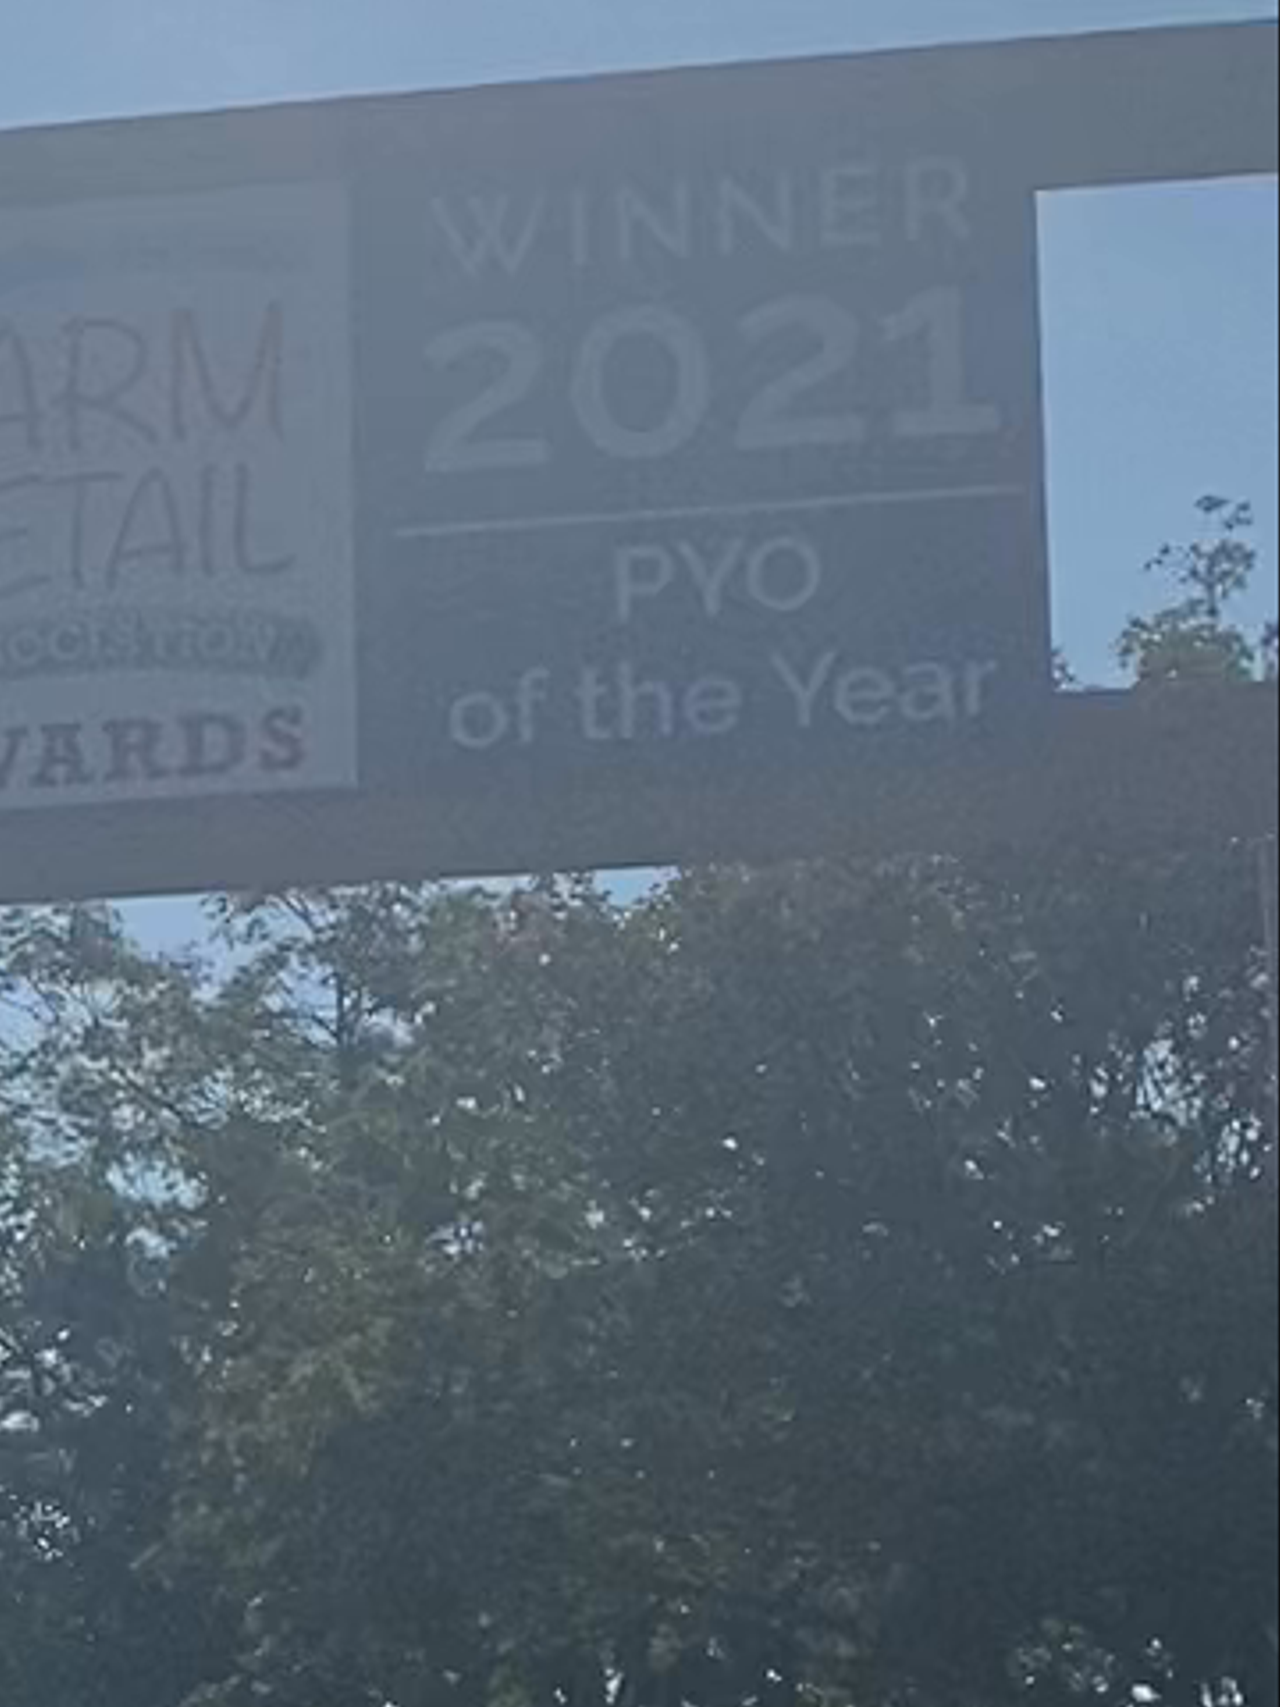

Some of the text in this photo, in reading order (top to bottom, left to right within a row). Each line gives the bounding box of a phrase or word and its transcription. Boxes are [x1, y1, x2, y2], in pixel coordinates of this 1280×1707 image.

[428, 154, 974, 280] WINNER
[421, 283, 1003, 474] 2021
[614, 533, 823, 622] PYO
[447, 647, 1000, 751] of the Year
